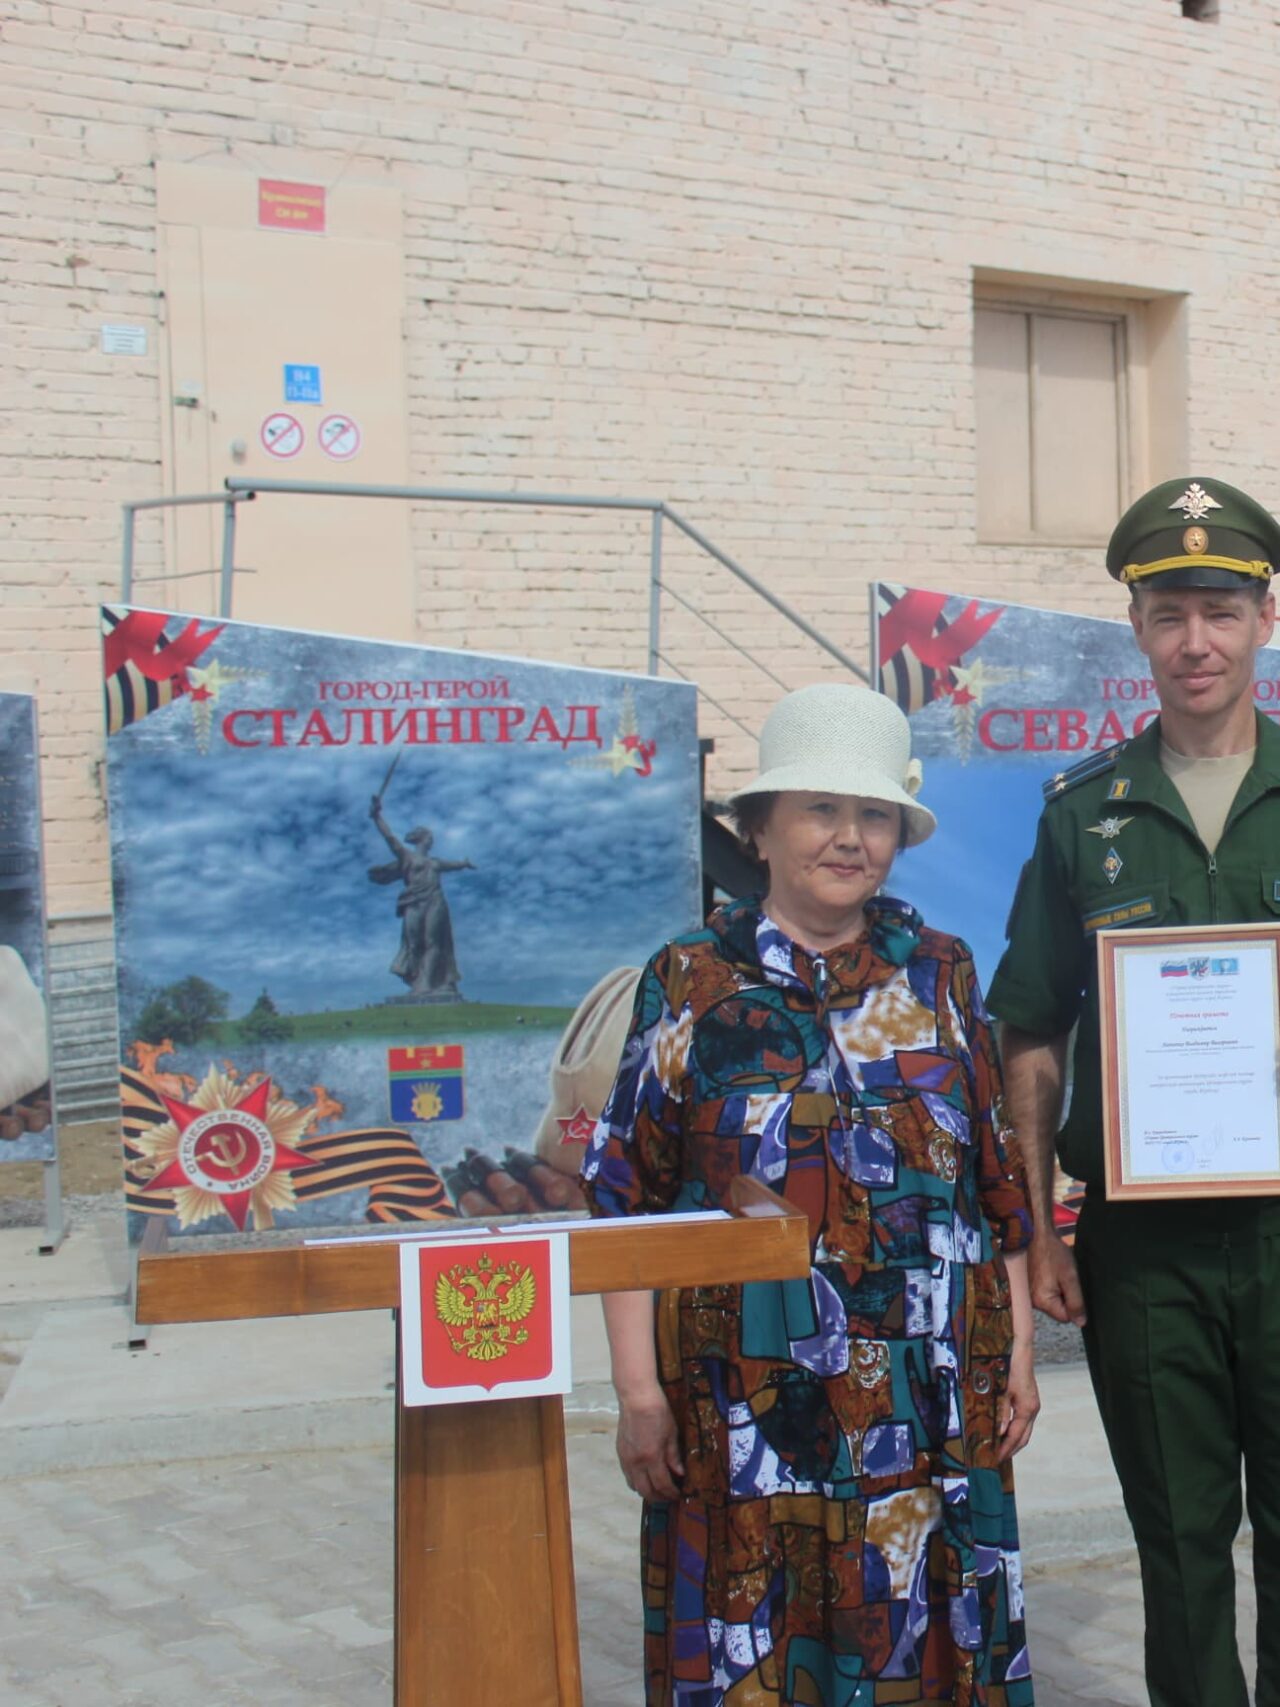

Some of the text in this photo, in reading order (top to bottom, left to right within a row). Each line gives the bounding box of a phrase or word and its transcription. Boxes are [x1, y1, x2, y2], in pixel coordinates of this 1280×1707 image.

[319, 675, 510, 704] ГОРОД-ГЕРОЙ
[221, 705, 603, 750] СТАЛИНГРАД
[183, 1113, 271, 1174] ОТЕЧЕСТВЕННАЯ
[228, 1154, 271, 1190] ВОЙНА
